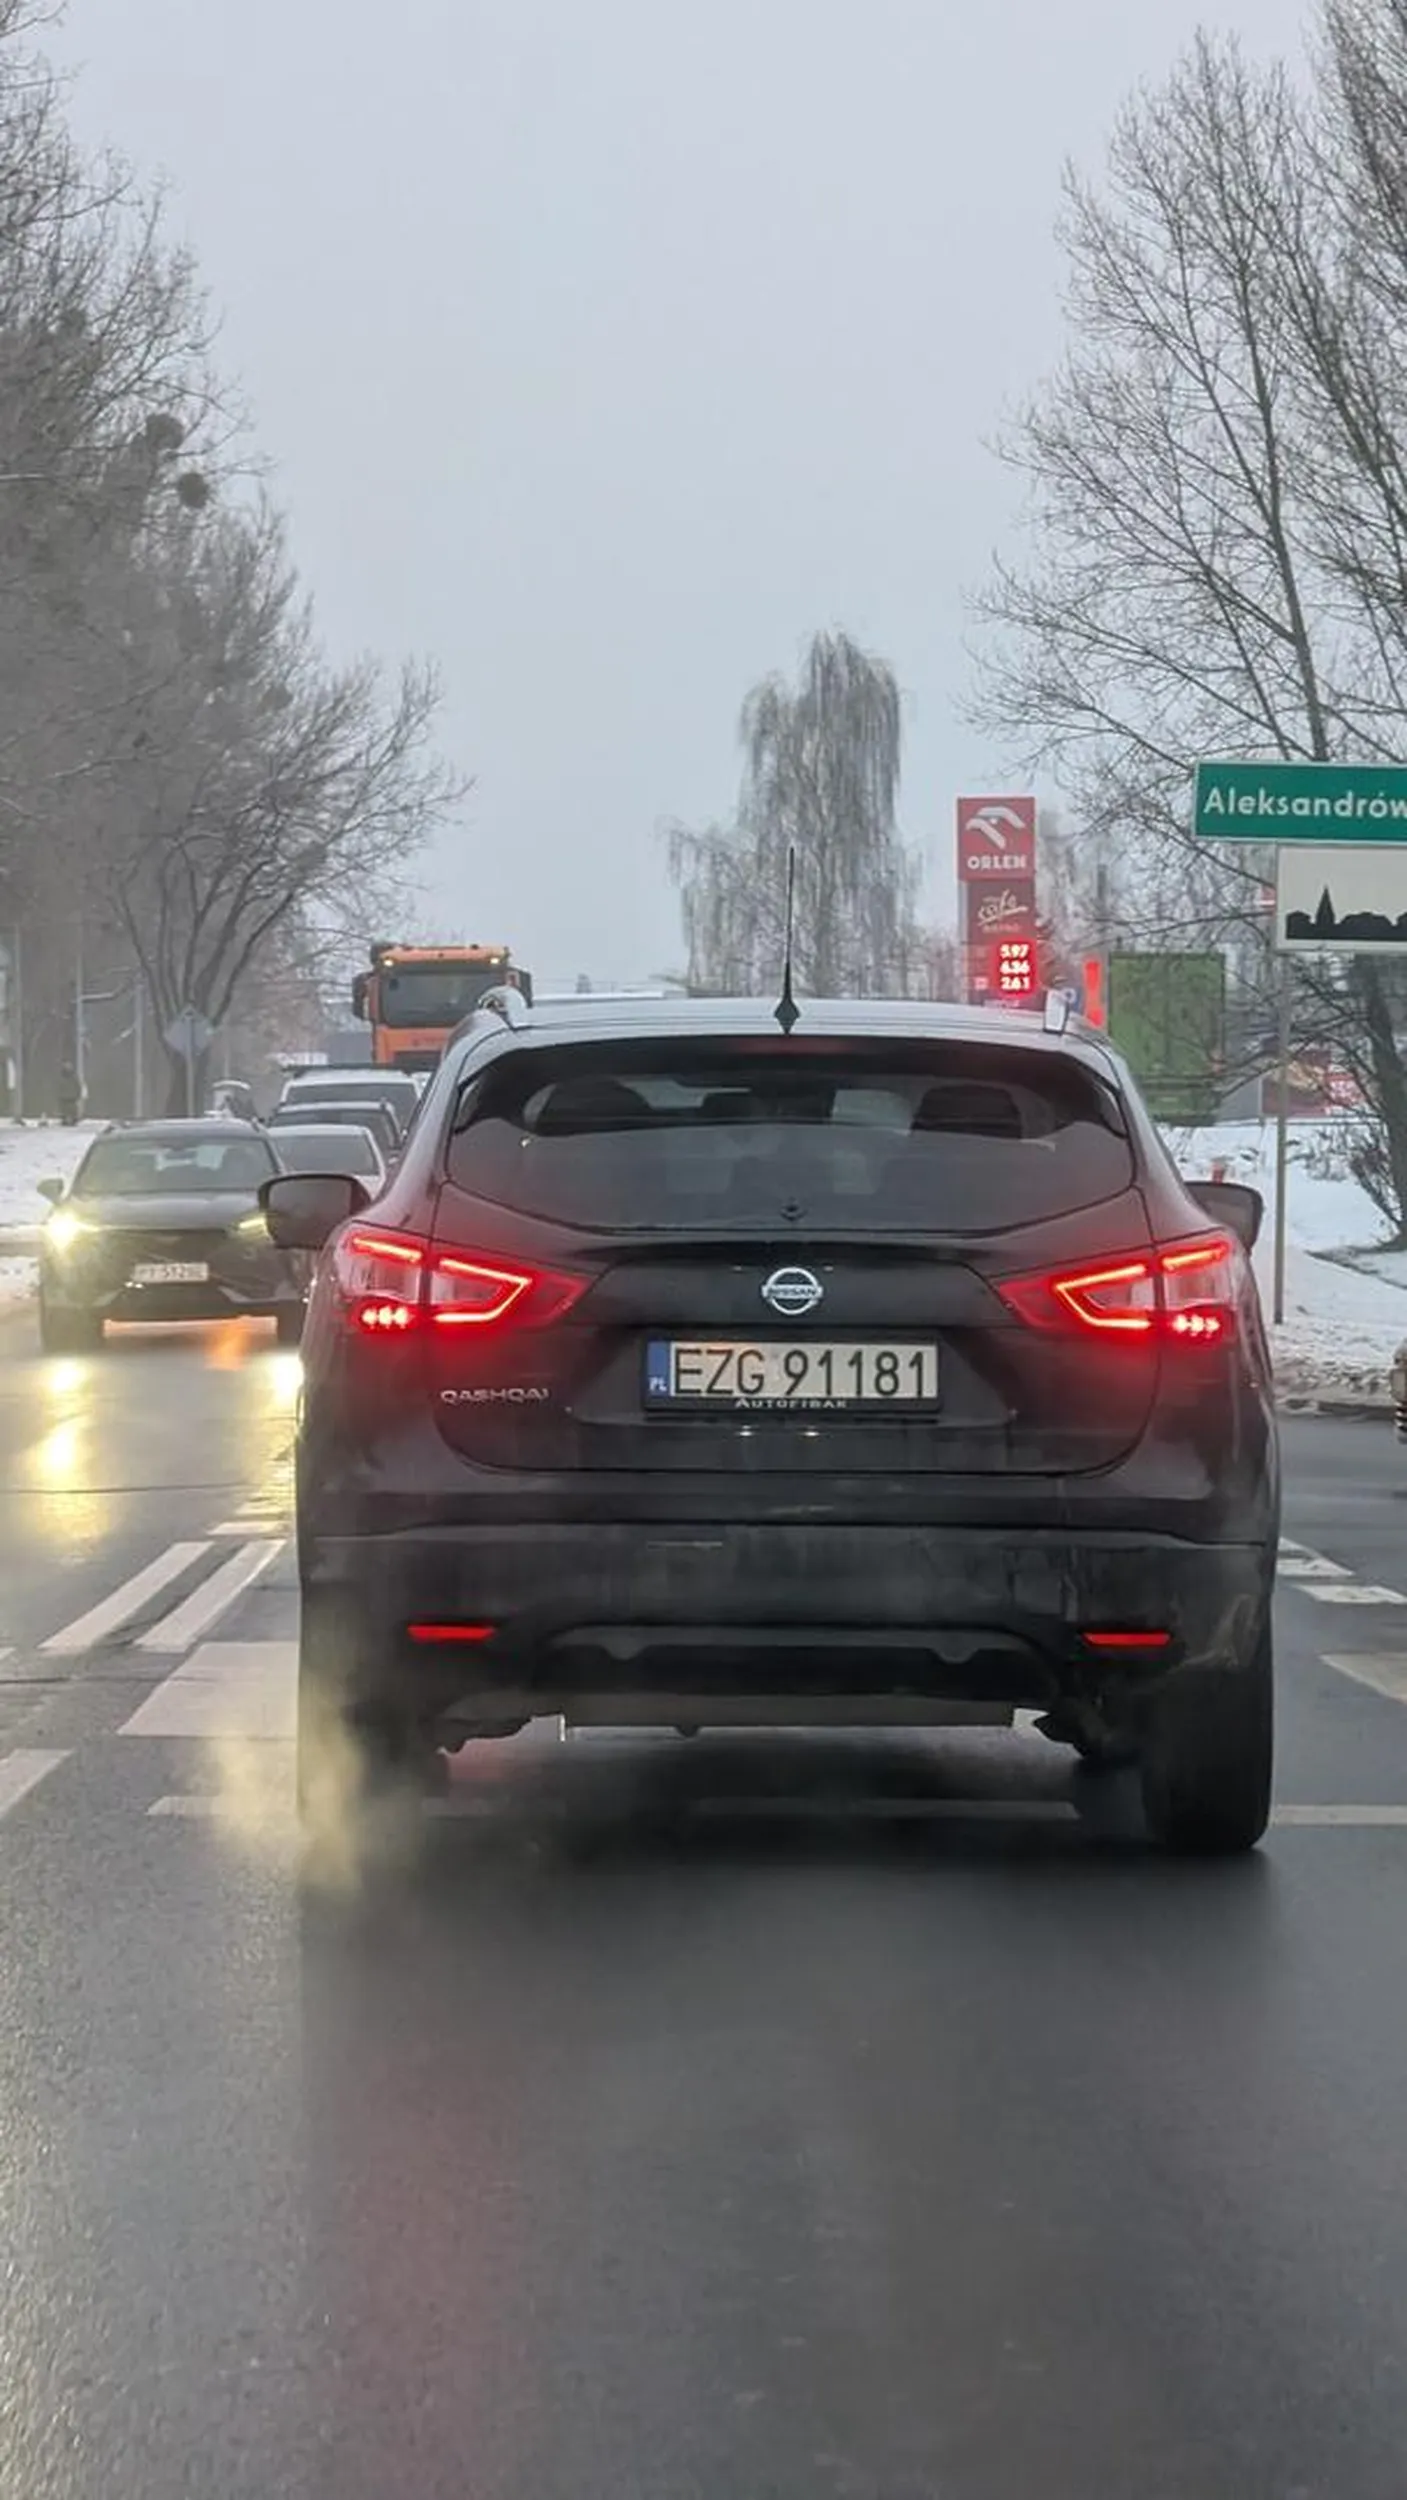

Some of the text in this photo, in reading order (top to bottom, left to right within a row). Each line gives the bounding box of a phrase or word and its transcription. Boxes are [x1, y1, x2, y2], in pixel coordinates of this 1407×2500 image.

[1203, 786, 1407, 819] Aleksandrów
[967, 855, 1027, 870] ORLEN
[768, 1285, 817, 1298] NISSAN
[674, 1348, 924, 1398] EZG 91181
[440, 1387, 550, 1405] QASHQAI
